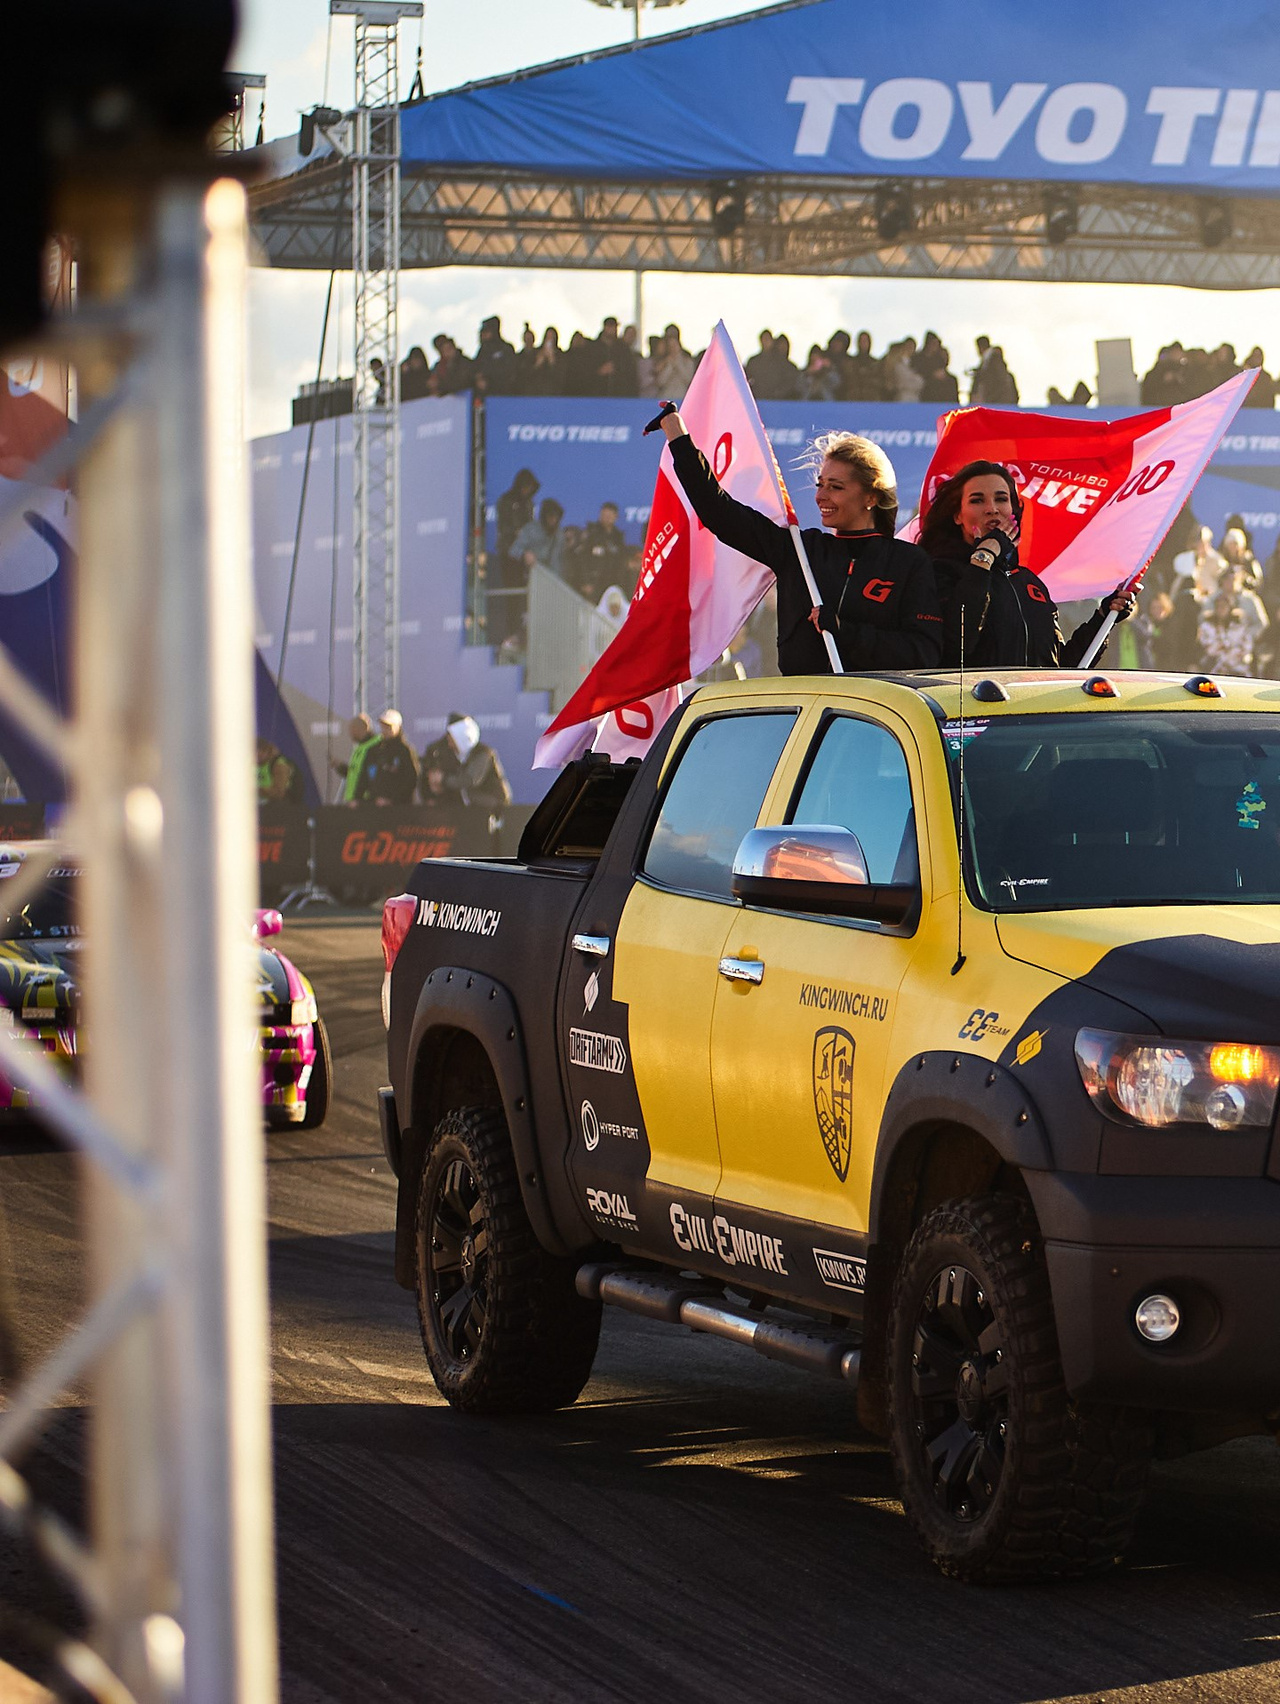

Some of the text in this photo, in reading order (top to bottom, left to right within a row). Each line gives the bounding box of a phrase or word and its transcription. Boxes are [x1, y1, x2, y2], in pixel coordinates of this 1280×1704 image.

[786, 76, 1128, 164] TOYO
[508, 425, 630, 442] TOYO TIRES
[862, 578, 895, 603] G
[437, 903, 501, 936] KINGWINCH
[799, 984, 888, 1021] KINGWINCH.RU
[600, 1122, 639, 1140] HYPER PORT
[586, 1187, 637, 1221] ROYAL
[669, 1202, 789, 1276] EVIL EMPIRE
